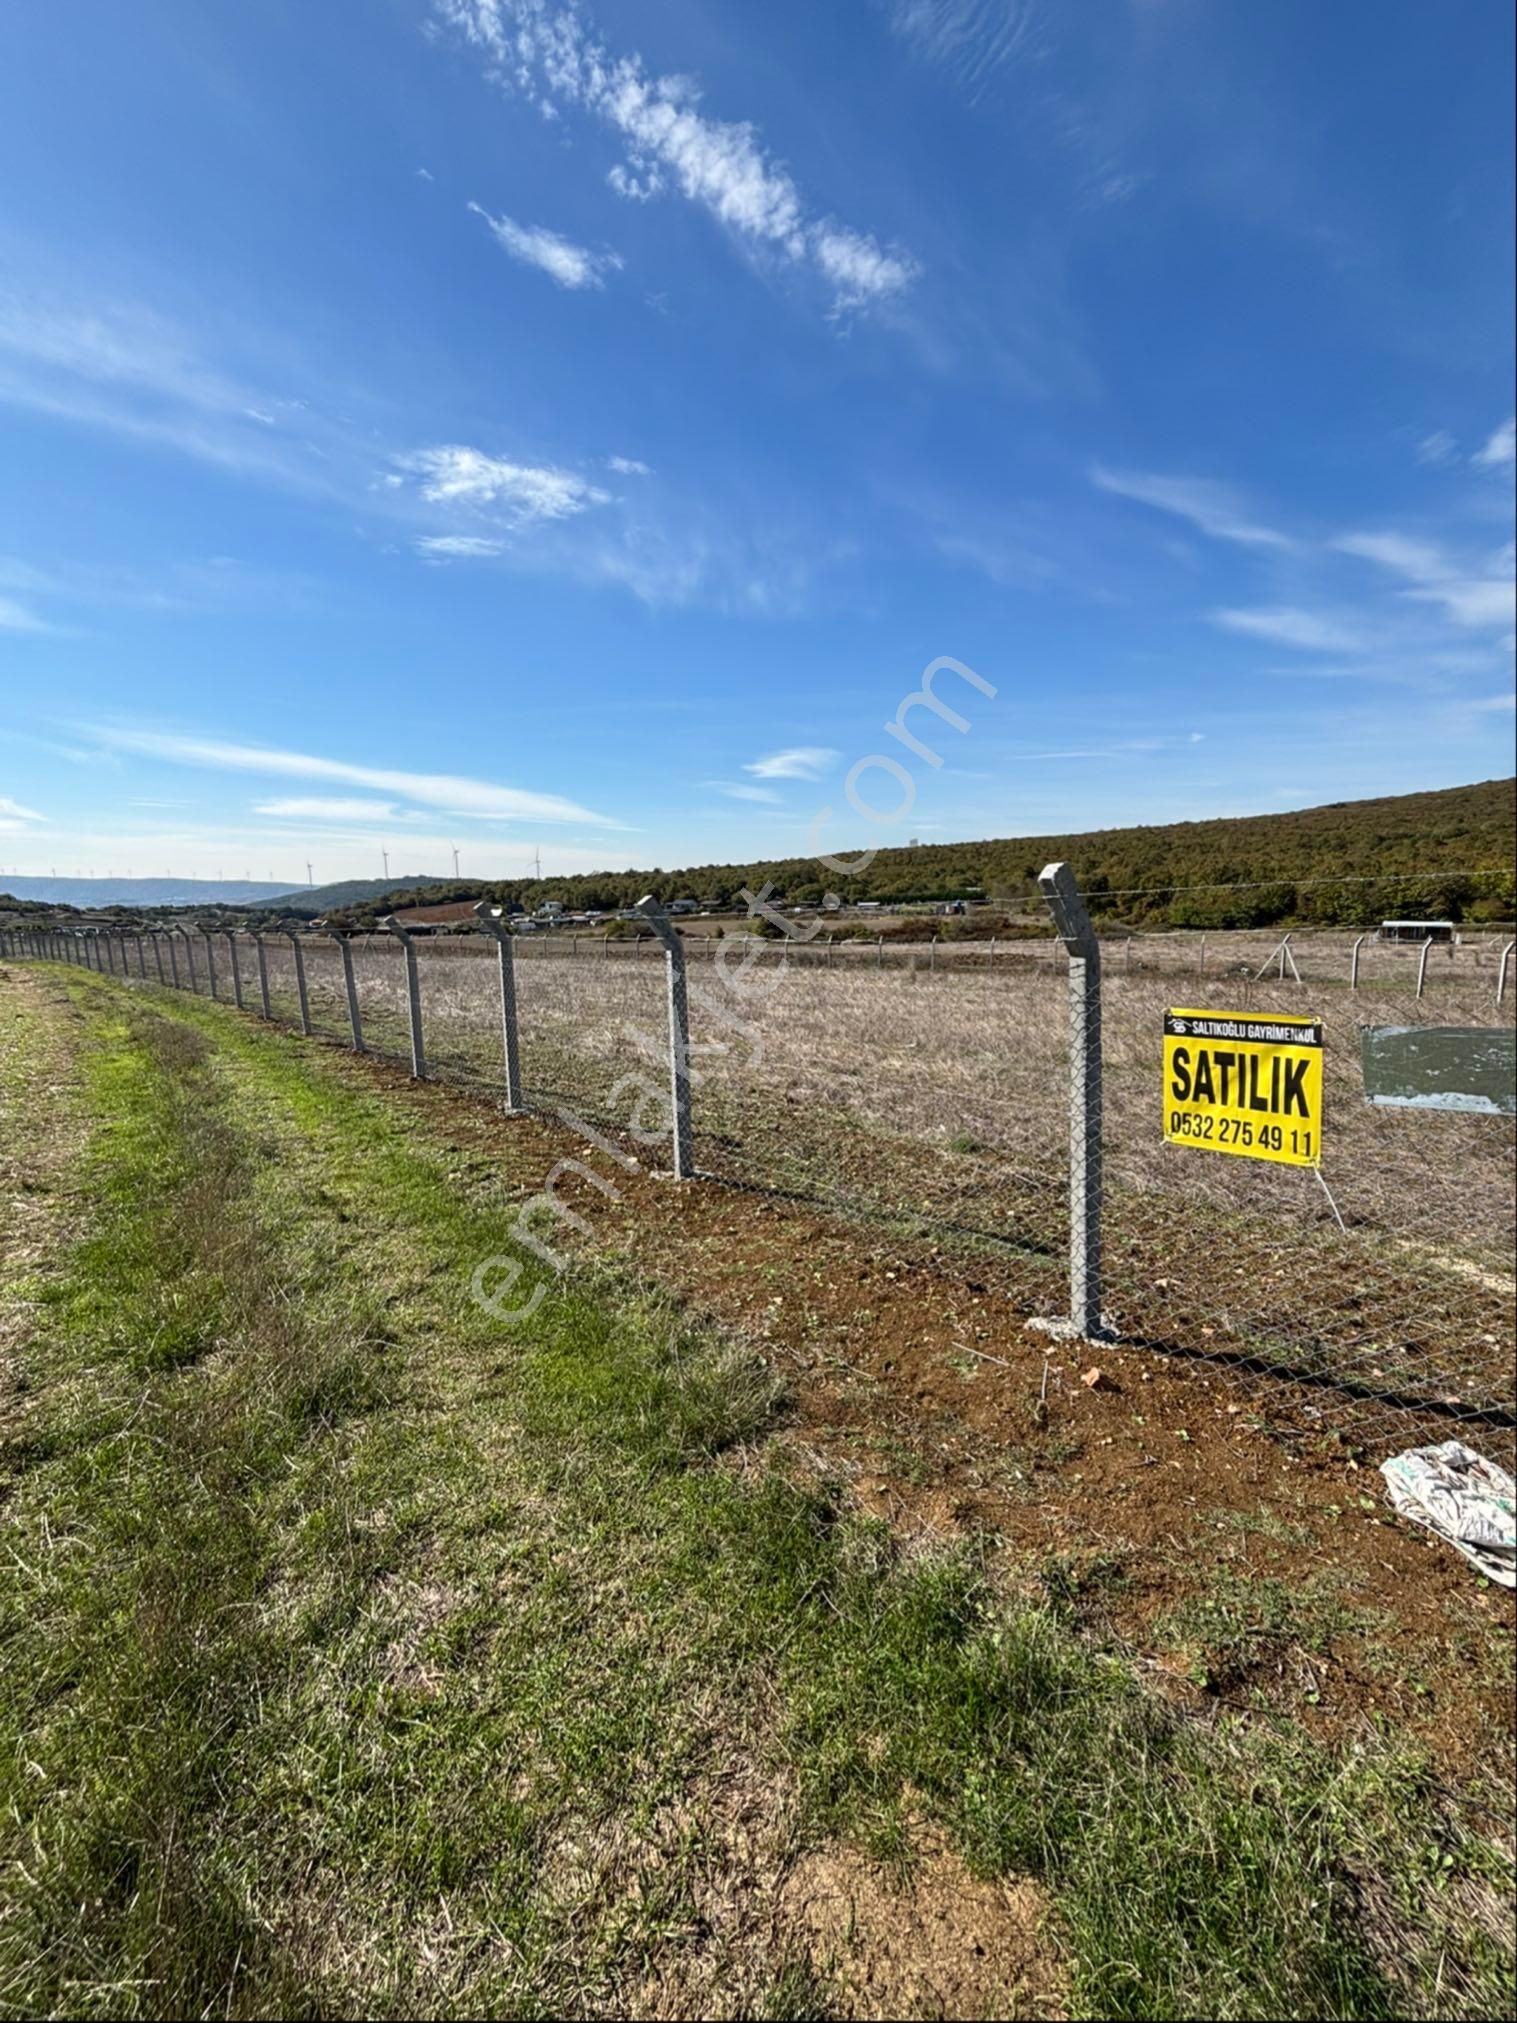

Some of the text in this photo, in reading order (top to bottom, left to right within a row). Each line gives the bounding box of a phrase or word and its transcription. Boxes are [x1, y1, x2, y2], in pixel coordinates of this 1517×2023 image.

[1192, 1020, 1246, 1038] SALTIKOĞLU
[1171, 1047, 1311, 1119] SATILIK
[1171, 1111, 1312, 1157] 0532 275 49 11
